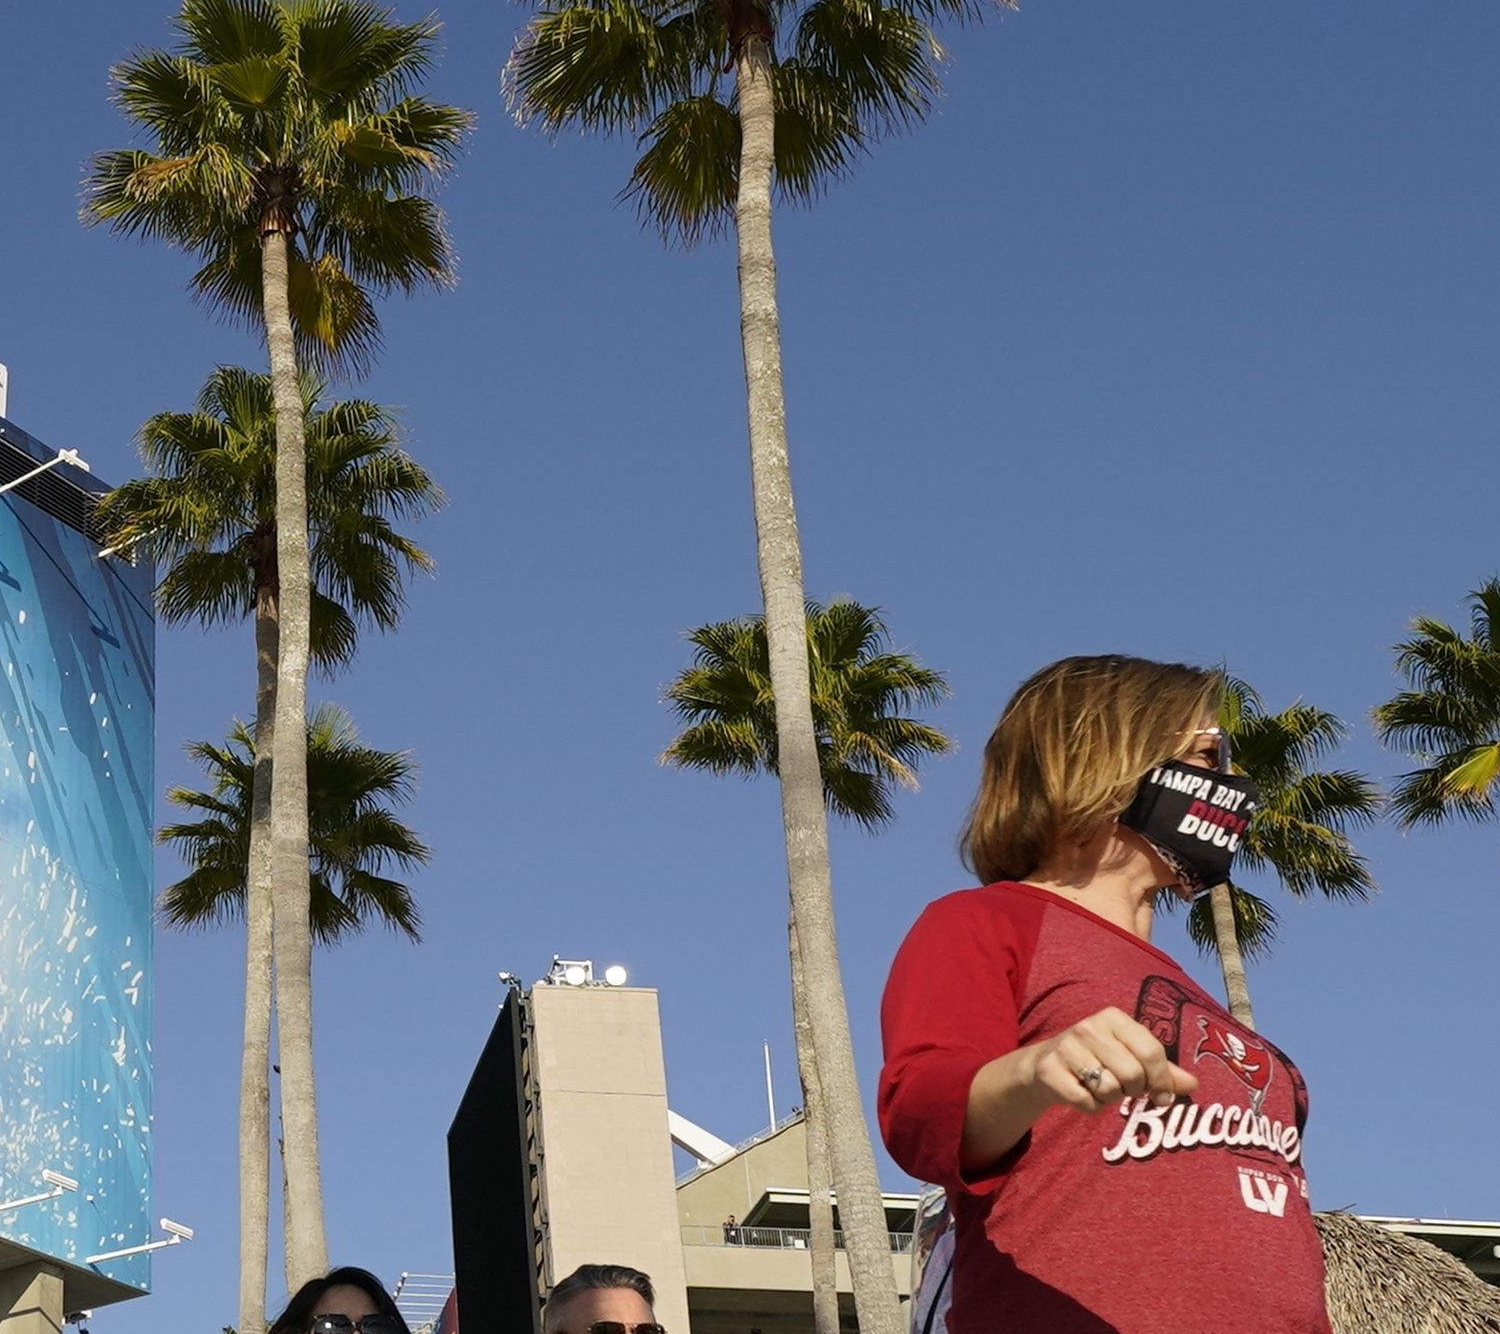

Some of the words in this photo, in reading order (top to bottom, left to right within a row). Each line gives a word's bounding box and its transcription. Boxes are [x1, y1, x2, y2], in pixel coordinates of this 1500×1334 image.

[1150, 767, 1213, 801] TAMPA
[1210, 784, 1247, 812] BAY
[1238, 1173, 1289, 1218] LV
